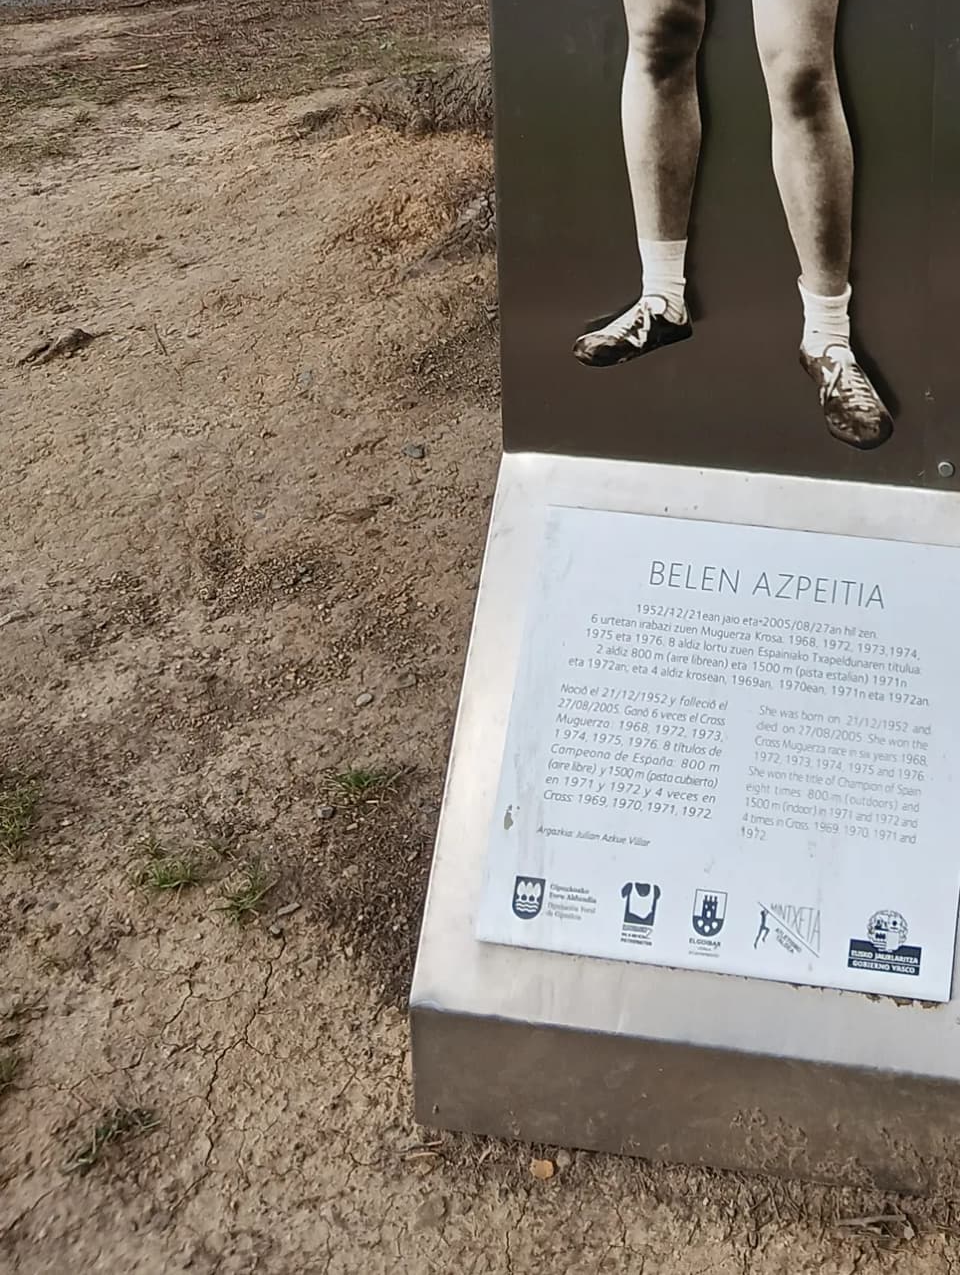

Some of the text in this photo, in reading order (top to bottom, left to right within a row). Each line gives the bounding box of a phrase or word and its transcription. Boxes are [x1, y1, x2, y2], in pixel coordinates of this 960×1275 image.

[649, 560, 885, 609] BELEN AZPEITIA
[585, 628, 613, 640] 1975
[615, 631, 631, 642] eta
[668, 637, 675, 647] 8
[677, 638, 700, 650] aldiz
[702, 640, 727, 652] lortu
[729, 646, 753, 655] zuen
[590, 614, 598, 623] 6
[701, 626, 751, 642] Muguerza
[568, 656, 584, 667] eta
[631, 663, 648, 674] eta
[650, 665, 658, 675] 4
[660, 666, 683, 678] aldiz
[596, 644, 602, 654] 2
[605, 645, 628, 657] aldiz
[630, 648, 650, 659] 800
[665, 651, 689, 665] (aire
[690, 654, 728, 670] librean)
[730, 659, 747, 670] eta
[752, 661, 780, 674] 1500
[795, 665, 823, 680] (pista
[590, 686, 599, 696] el
[601, 687, 667, 704] 21/12/1952
[668, 694, 676, 707] y
[679, 696, 716, 709] falleció
[718, 700, 728, 710] el
[623, 705, 649, 717] Ganó
[651, 708, 658, 718] 6
[660, 712, 686, 721] veces
[689, 712, 697, 722] el
[700, 713, 726, 725] Cross
[550, 743, 610, 762] Campeona
[614, 750, 628, 761] de
[680, 758, 705, 770] 800
[662, 740, 670, 750] 8
[708, 745, 722, 756] de
[599, 764, 606, 777] y
[608, 765, 633, 778] 1500
[634, 771, 644, 779] m
[545, 776, 715, 803] en 1971 y 1972 y 4 veces en
